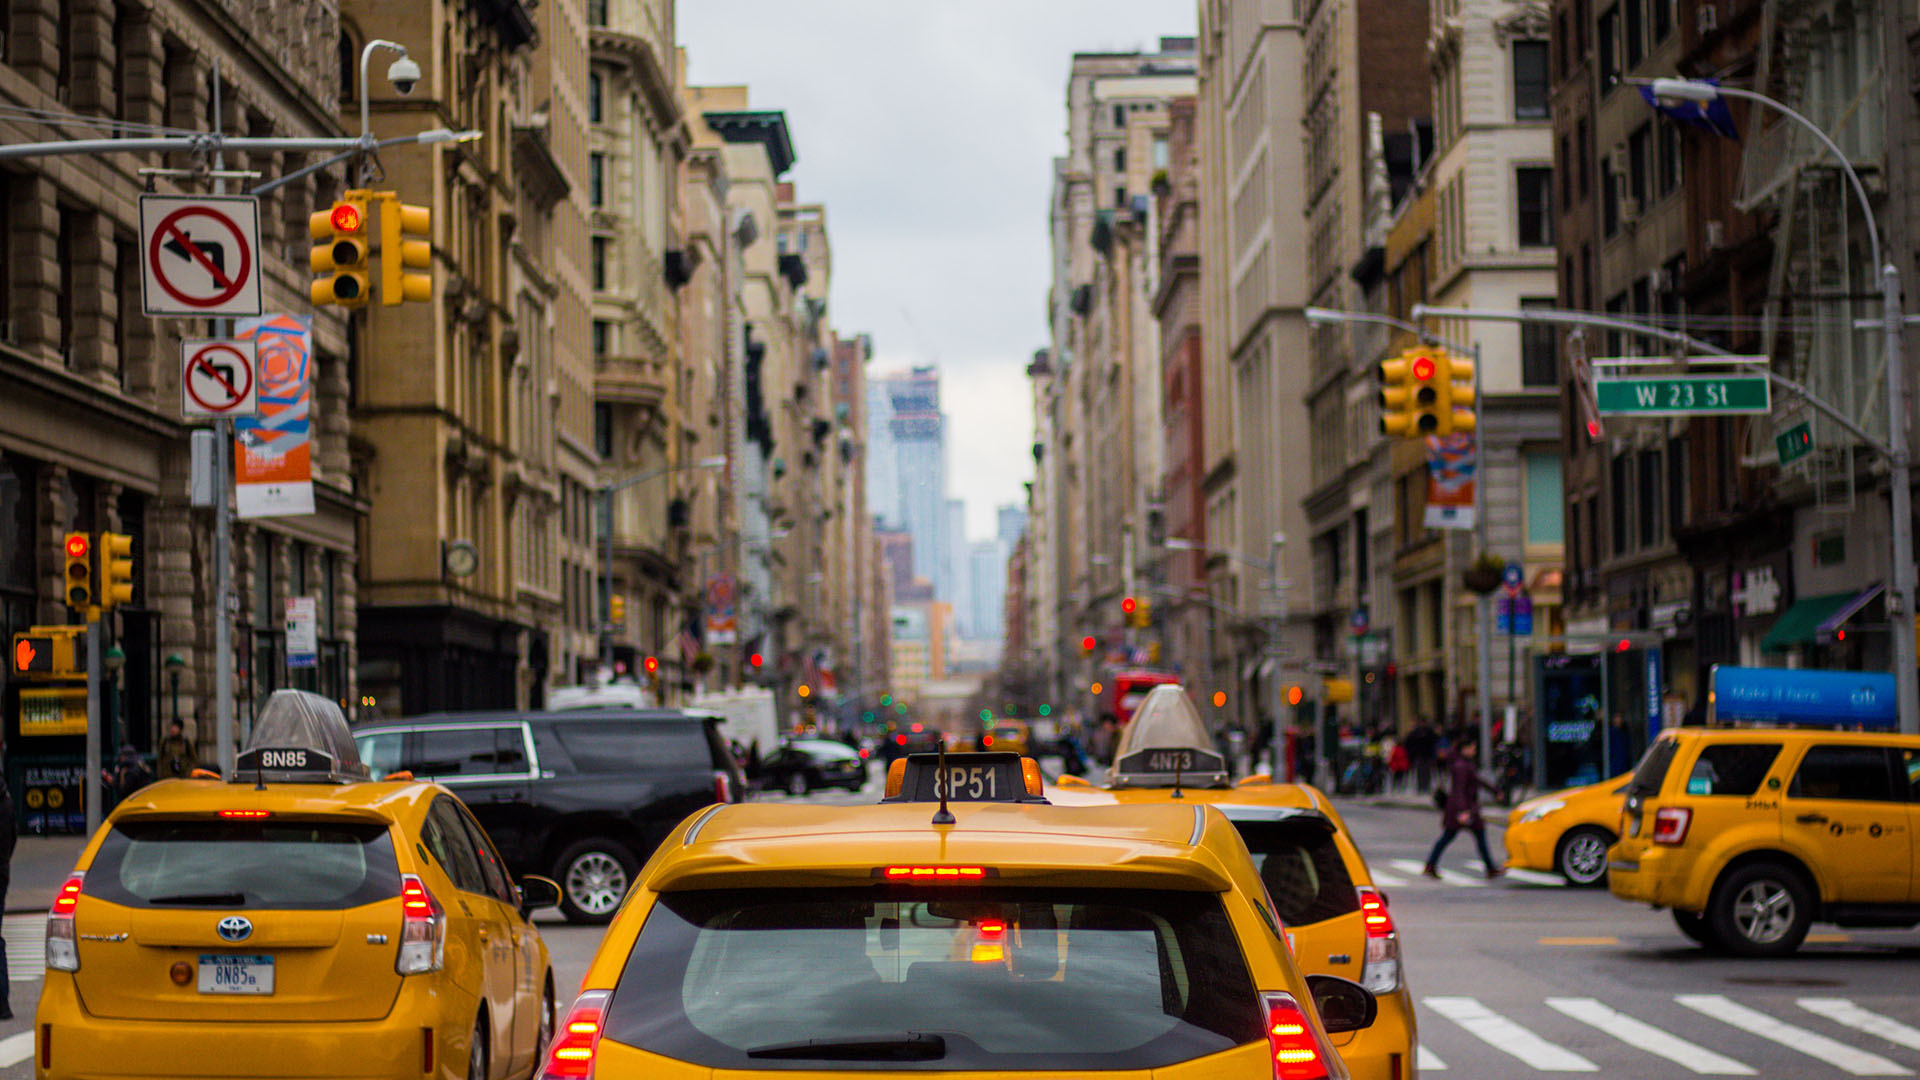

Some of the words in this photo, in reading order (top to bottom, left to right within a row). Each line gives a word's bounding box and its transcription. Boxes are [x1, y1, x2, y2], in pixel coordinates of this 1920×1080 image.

[1636, 383, 1657, 407] W
[1669, 383, 1695, 407] 23
[1705, 383, 1729, 407] St
[262, 751, 307, 767] 8N85
[1149, 751, 1192, 769] 4N73
[933, 767, 996, 799] 8P51
